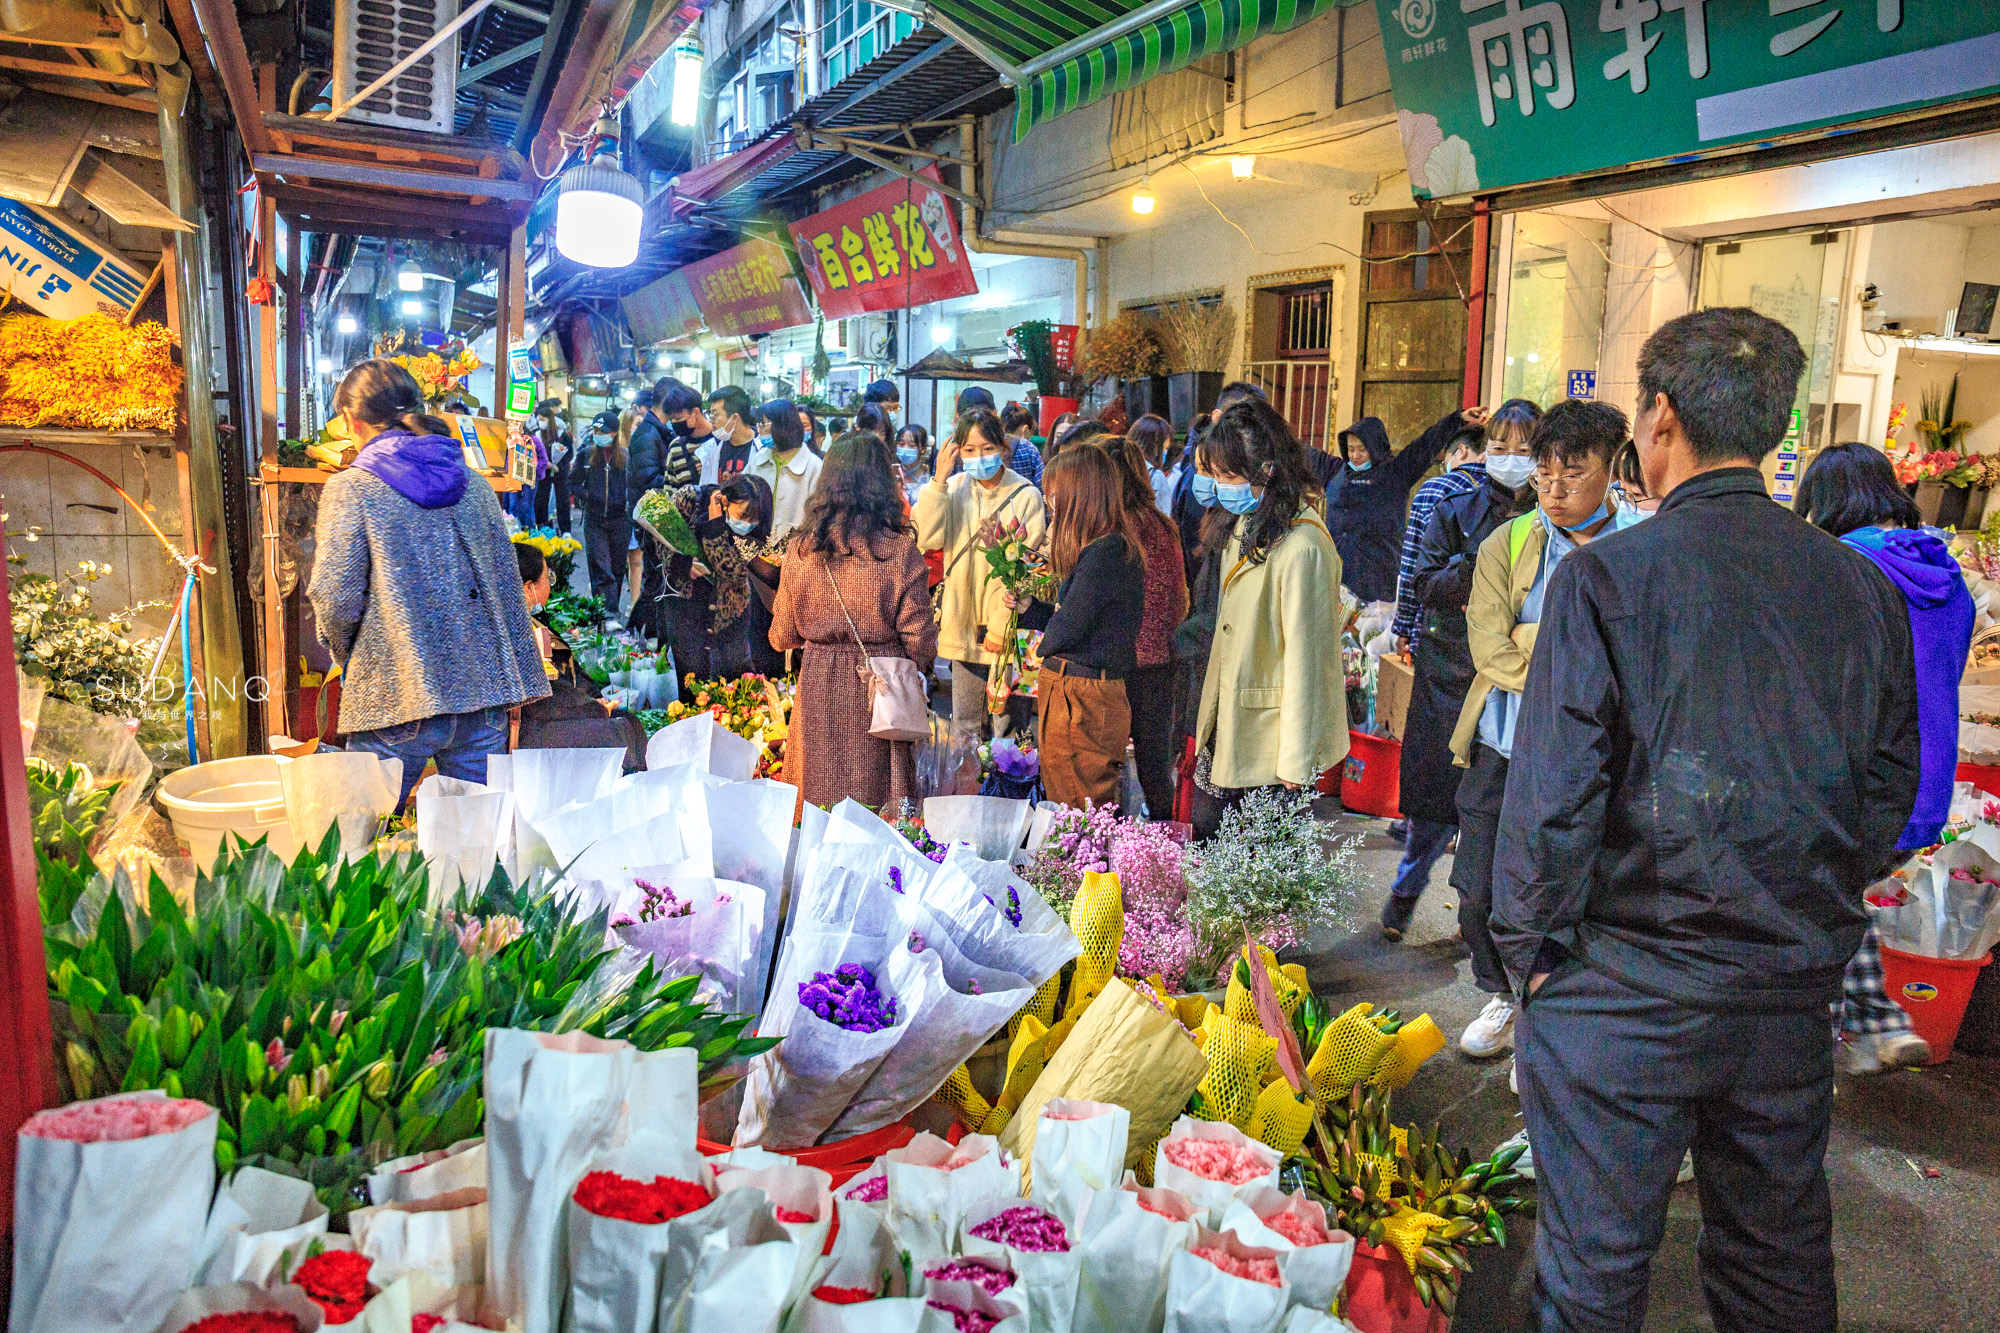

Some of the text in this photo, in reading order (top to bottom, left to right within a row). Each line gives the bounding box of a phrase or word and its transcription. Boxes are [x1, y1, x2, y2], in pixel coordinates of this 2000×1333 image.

[1401, 38, 1448, 64] 雨轩鲜花
[0, 211, 75, 263] FLORAL FOAM
[812, 200, 936, 291] 百合鲜花
[1573, 380, 1588, 395] 53
